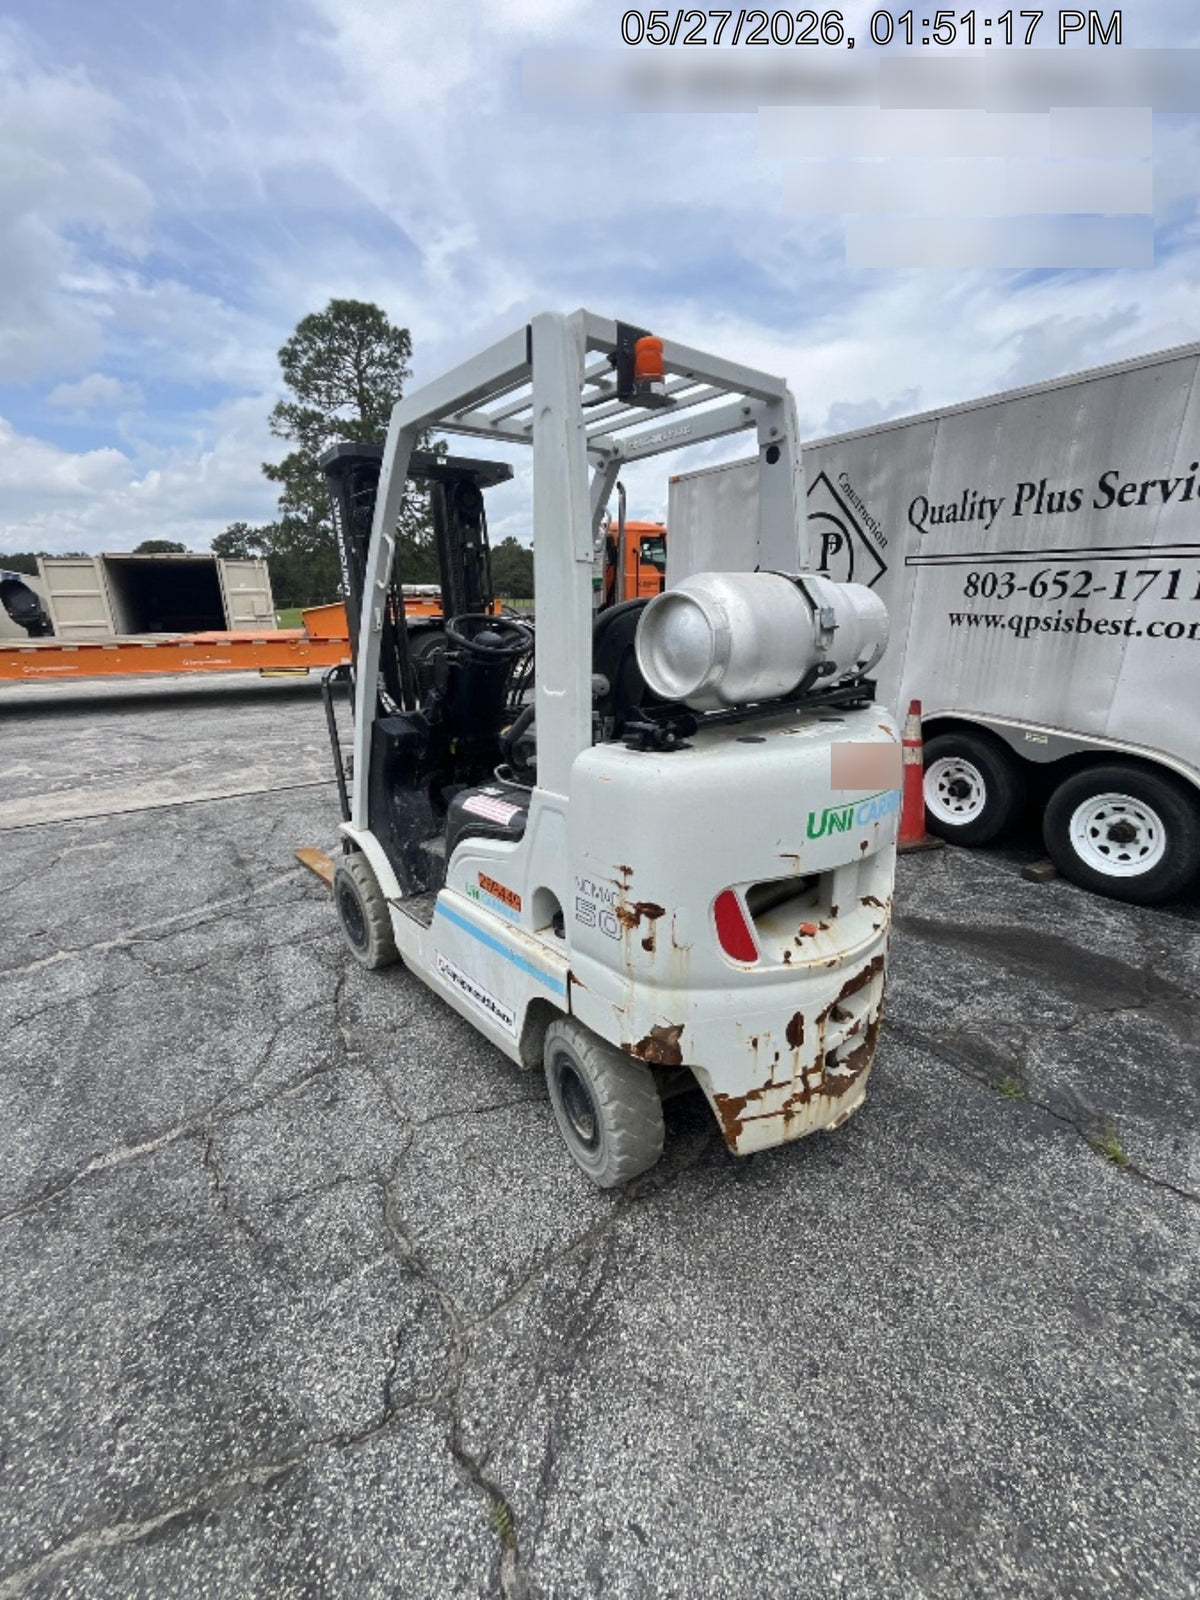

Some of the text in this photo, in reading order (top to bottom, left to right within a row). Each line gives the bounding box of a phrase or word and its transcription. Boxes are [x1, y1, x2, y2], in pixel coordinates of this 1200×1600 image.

[839, 472, 888, 548] Construction
[908, 461, 1200, 534] Quality Plus Servi
[575, 896, 623, 941] 50
